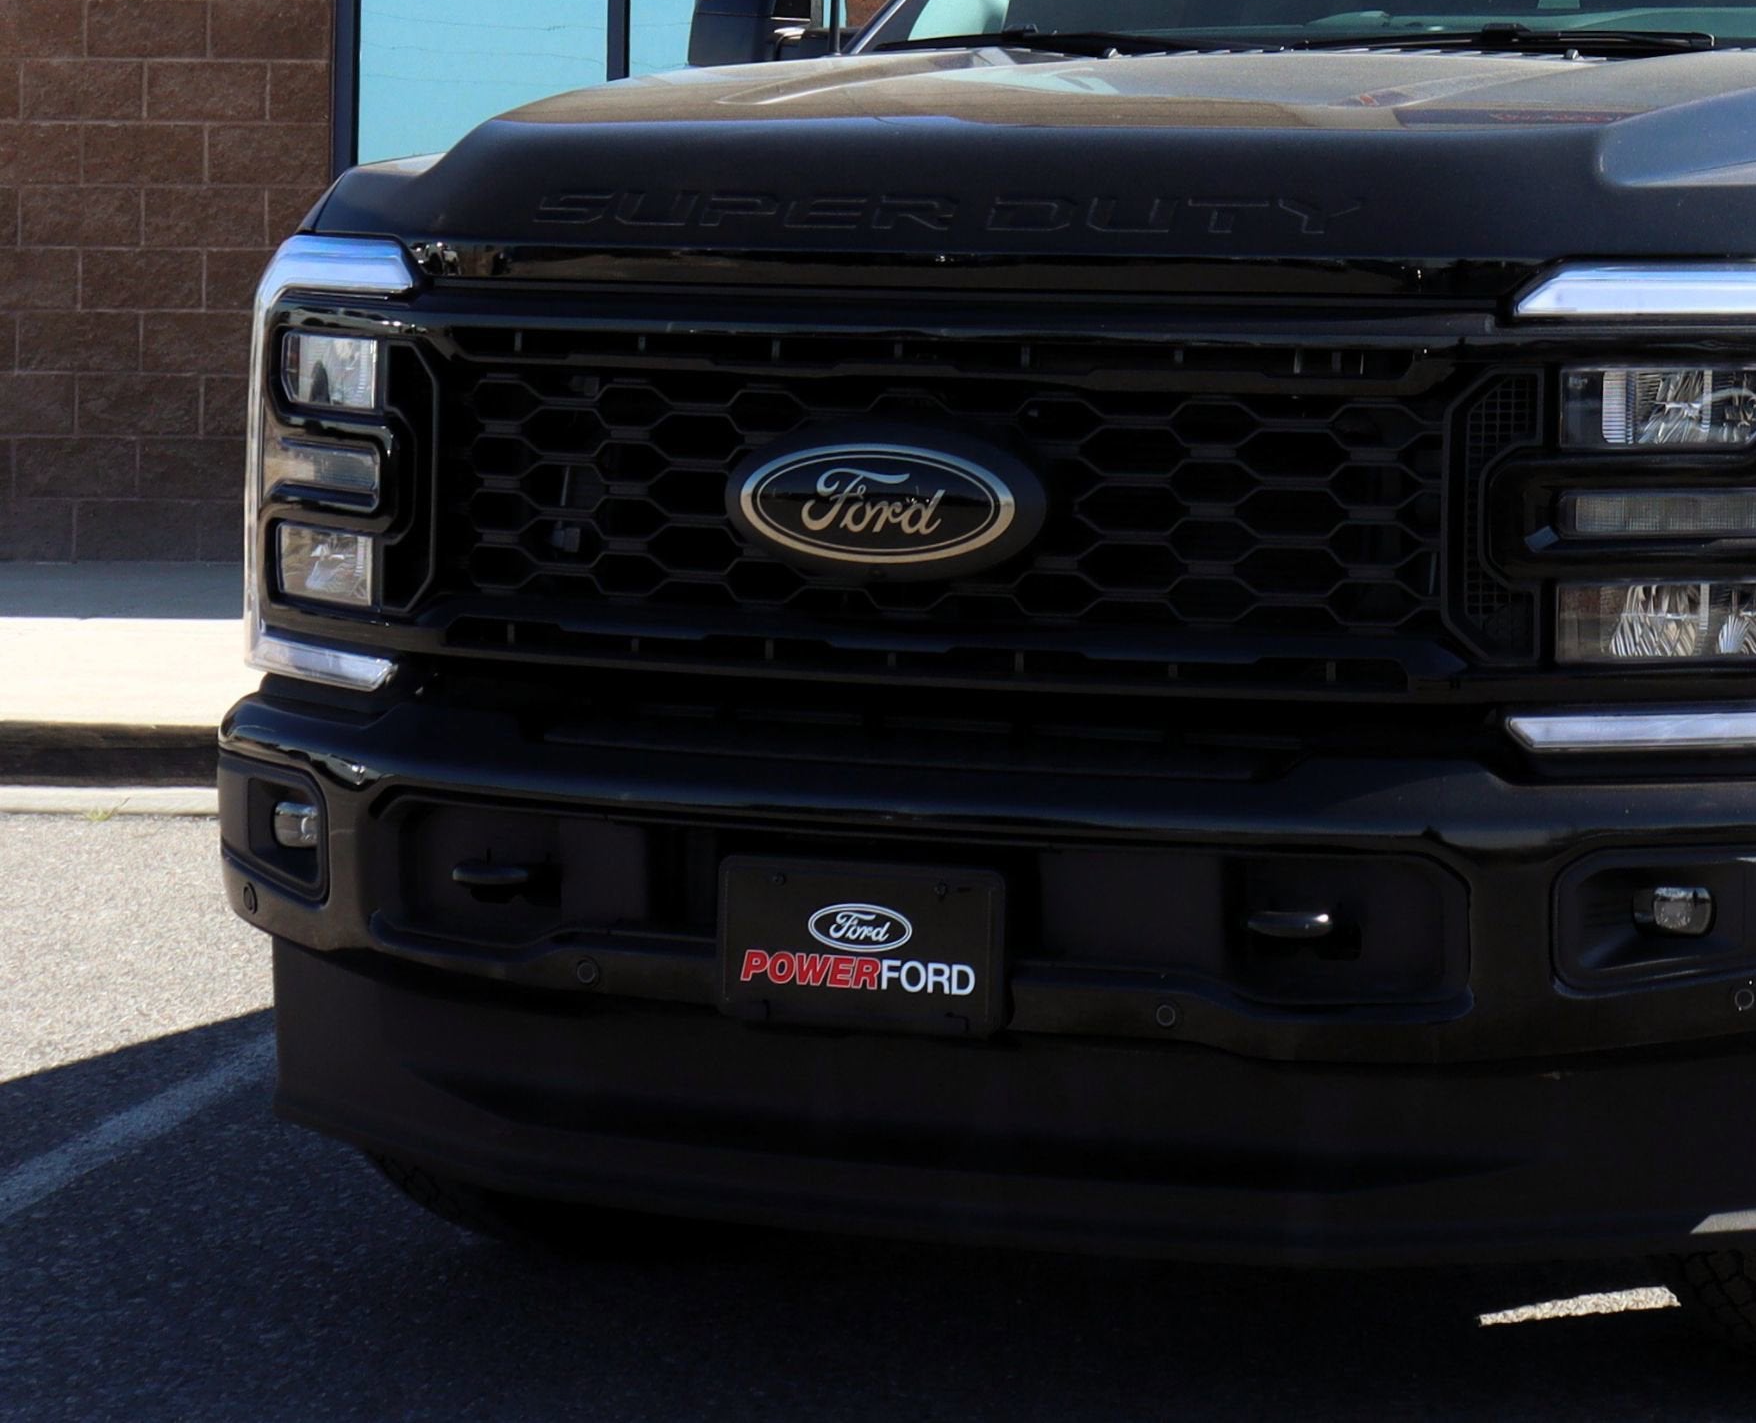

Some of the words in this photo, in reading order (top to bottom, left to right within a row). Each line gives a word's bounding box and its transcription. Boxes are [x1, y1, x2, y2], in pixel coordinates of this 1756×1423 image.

[532, 190, 960, 231] SUPER
[984, 194, 1362, 235] DUTY
[801, 467, 946, 535] Ford
[829, 911, 891, 943] Ford
[740, 949, 976, 996] POWERFORD
